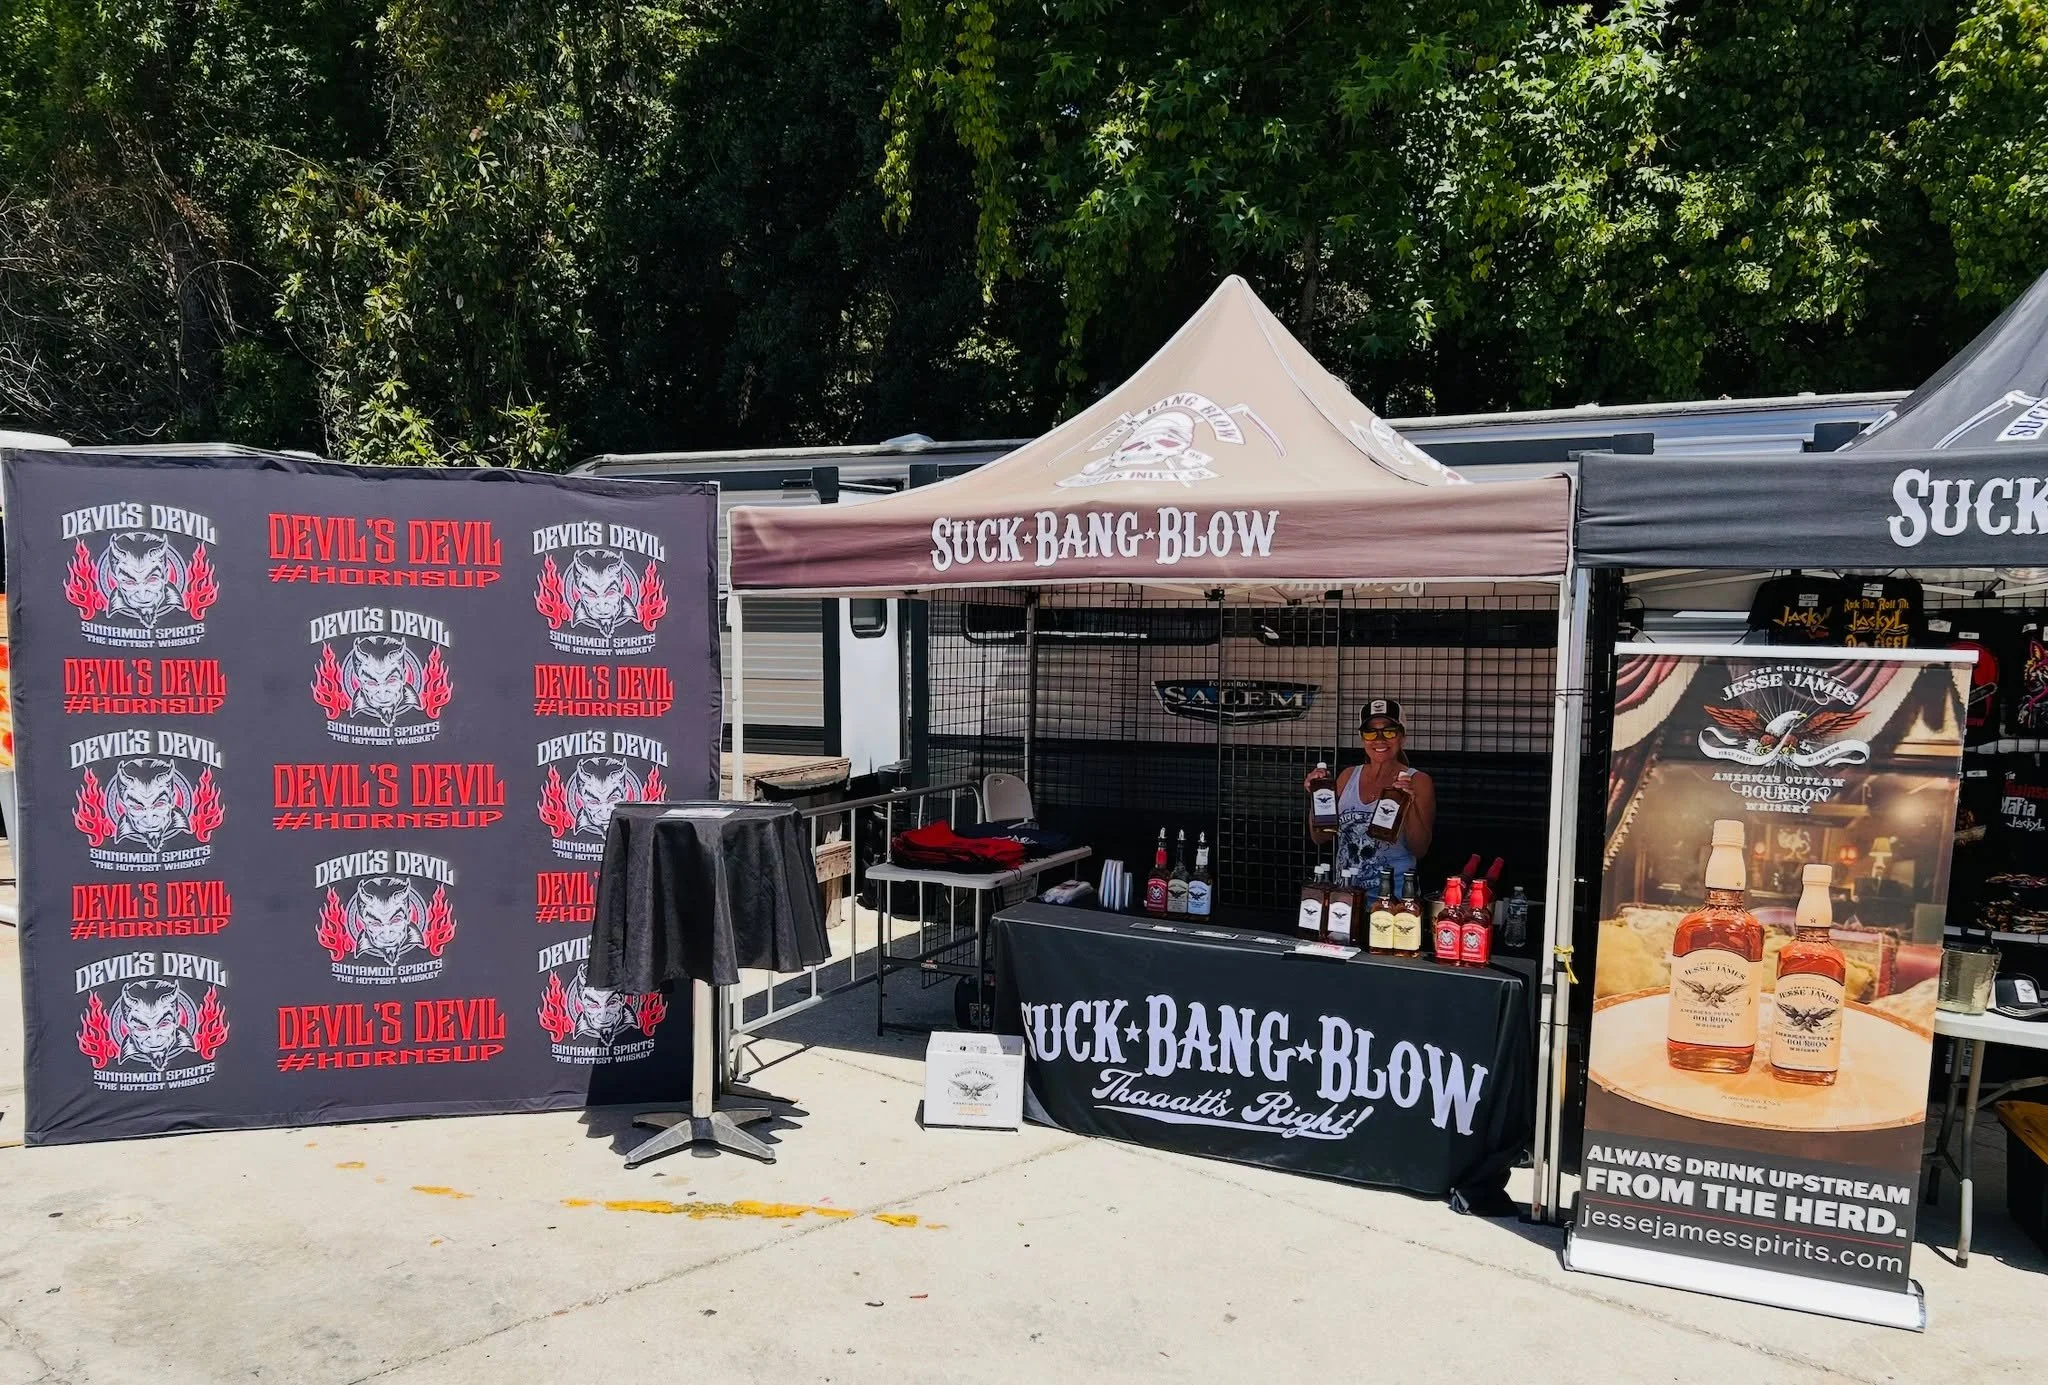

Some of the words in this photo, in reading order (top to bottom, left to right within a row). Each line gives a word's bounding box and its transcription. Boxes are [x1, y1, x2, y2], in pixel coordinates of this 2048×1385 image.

[1887, 468, 2048, 547] SUCK
[61, 501, 144, 540] DEVIL'S
[150, 504, 217, 545] DEVIL
[268, 513, 396, 564] DEVIL'S
[408, 520, 502, 567] DEVIL
[532, 521, 603, 556] DEVIL'S
[609, 524, 665, 562] DEVIL
[930, 516, 1024, 573] SUCK
[1034, 509, 1141, 567] BANG
[1155, 507, 1280, 566] BLOW
[268, 565, 501, 588] #HORNSUP
[81, 621, 151, 640] SINNAMON
[155, 622, 205, 639] SPIRITS
[309, 606, 385, 644] DEVIL'S
[391, 609, 450, 648] DEVIL
[549, 630, 610, 647] SINNAMON
[613, 633, 656, 647] SPIRITS
[108, 638, 155, 648] HOTTEST
[573, 645, 613, 655] HOTTEST
[64, 658, 153, 696] DEVIL'S
[160, 659, 226, 697] DEVIL
[534, 664, 610, 700] DEVIL'S
[616, 665, 674, 701] DEVIL
[1750, 666, 1772, 677] THE
[1776, 665, 1829, 679] ORIGINAL
[1164, 686, 1307, 708] SALEM
[1721, 673, 1783, 701] JESSE
[1789, 674, 1859, 706] JAMES
[63, 697, 225, 715] #HORNSUP
[534, 701, 672, 717] #HORNSUP
[327, 721, 391, 737] SINNAMON
[394, 721, 440, 737] SPIRITS
[70, 729, 151, 769] DEVIL'S
[158, 730, 224, 769] DEVIL
[351, 736, 394, 747] HOTTEST
[536, 730, 606, 767] DEVIL'S
[612, 731, 669, 767] DEVIL
[273, 762, 398, 808] DEVIL'S
[411, 763, 505, 808] DEVIL
[1730, 781, 1831, 804] BOURBON
[1785, 775, 1847, 788] OUTLAW
[1746, 802, 1812, 814] WHISKEY
[272, 810, 503, 830] #HORNSUP
[90, 848, 158, 863] SINNAMON
[162, 845, 211, 861] SPIRITS
[552, 838, 604, 854] SINNAMO
[575, 852, 604, 862] HOTTE
[115, 862, 163, 873] HOTTEST
[315, 850, 390, 889] DEVIL'S
[395, 850, 454, 887] DEVIL
[536, 871, 601, 907] DEVIL'
[71, 882, 159, 922] DEVIL'S
[165, 880, 232, 918] DEVIL
[70, 918, 229, 941] #HORNSUP
[75, 952, 155, 994] DEVIL'S
[163, 953, 228, 988] DEVIL
[331, 961, 394, 977] SINNAMON
[398, 958, 443, 976] SPIRITS
[1717, 965, 1747, 980] JAMES
[355, 974, 398, 985] HOTTEST
[1811, 990, 1840, 1004] JAMES
[277, 1001, 402, 1051] DEVIL'S
[414, 997, 506, 1043] DEVIL
[277, 1044, 505, 1072] #HORNSUP
[551, 1043, 609, 1057] SINNAMON
[613, 1039, 655, 1055] SPIRITS
[574, 1056, 613, 1065] HOTTEST
[1145, 994, 1295, 1082] BANG
[1317, 1015, 1489, 1136] BLOW
[93, 1069, 162, 1083] SINNAMON
[165, 1062, 216, 1081] SPIRITS
[119, 1082, 166, 1092] HOTTEST
[1241, 1091, 1375, 1139] Right!
[1586, 1145, 1682, 1173] ALWAYS
[1685, 1158, 1765, 1185] DRINK
[1768, 1169, 1910, 1205] UPSTREAM
[1586, 1166, 1696, 1206] FROM
[1701, 1183, 1776, 1219] THE
[1784, 1196, 1908, 1238] HERD.
[1581, 1204, 1904, 1274] jessejamesspirits.com
